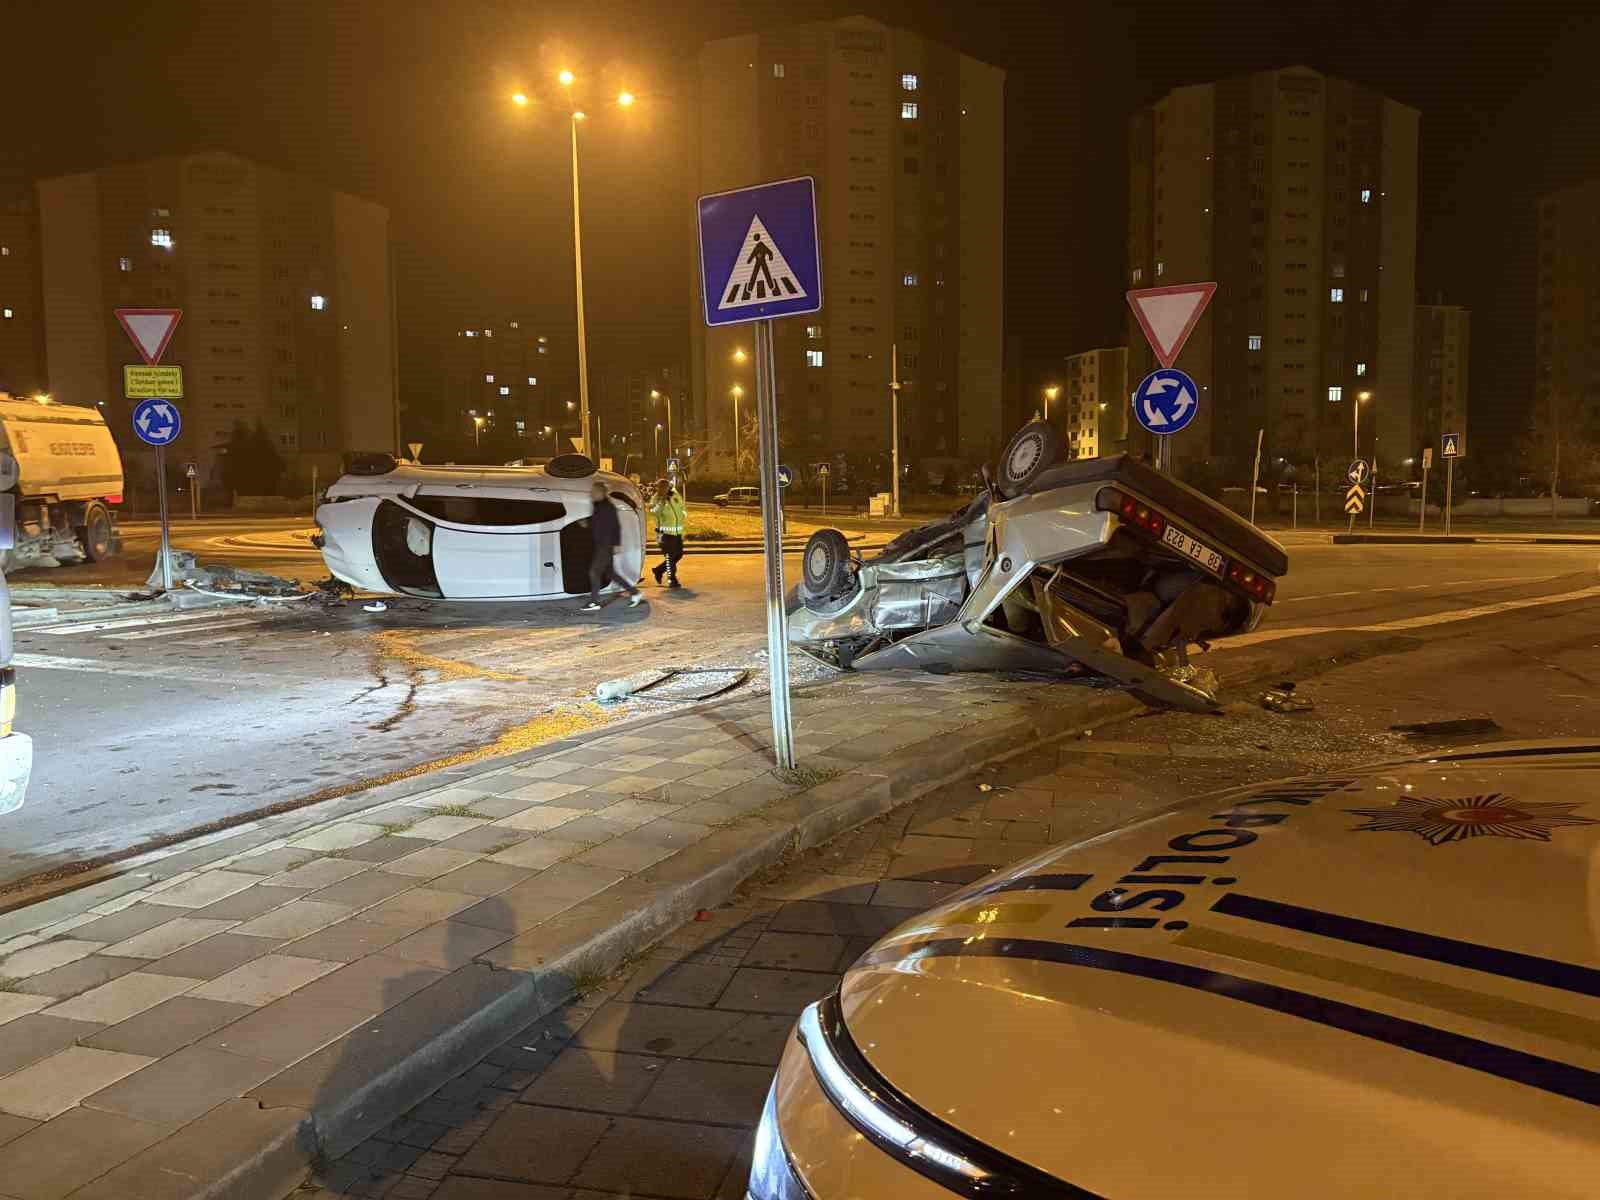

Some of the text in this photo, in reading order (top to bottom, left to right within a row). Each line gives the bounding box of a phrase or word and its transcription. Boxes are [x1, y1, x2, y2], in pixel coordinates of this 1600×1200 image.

[1166, 528, 1221, 569] 38 EA 823
[1065, 813, 1291, 931] POLİSİ
